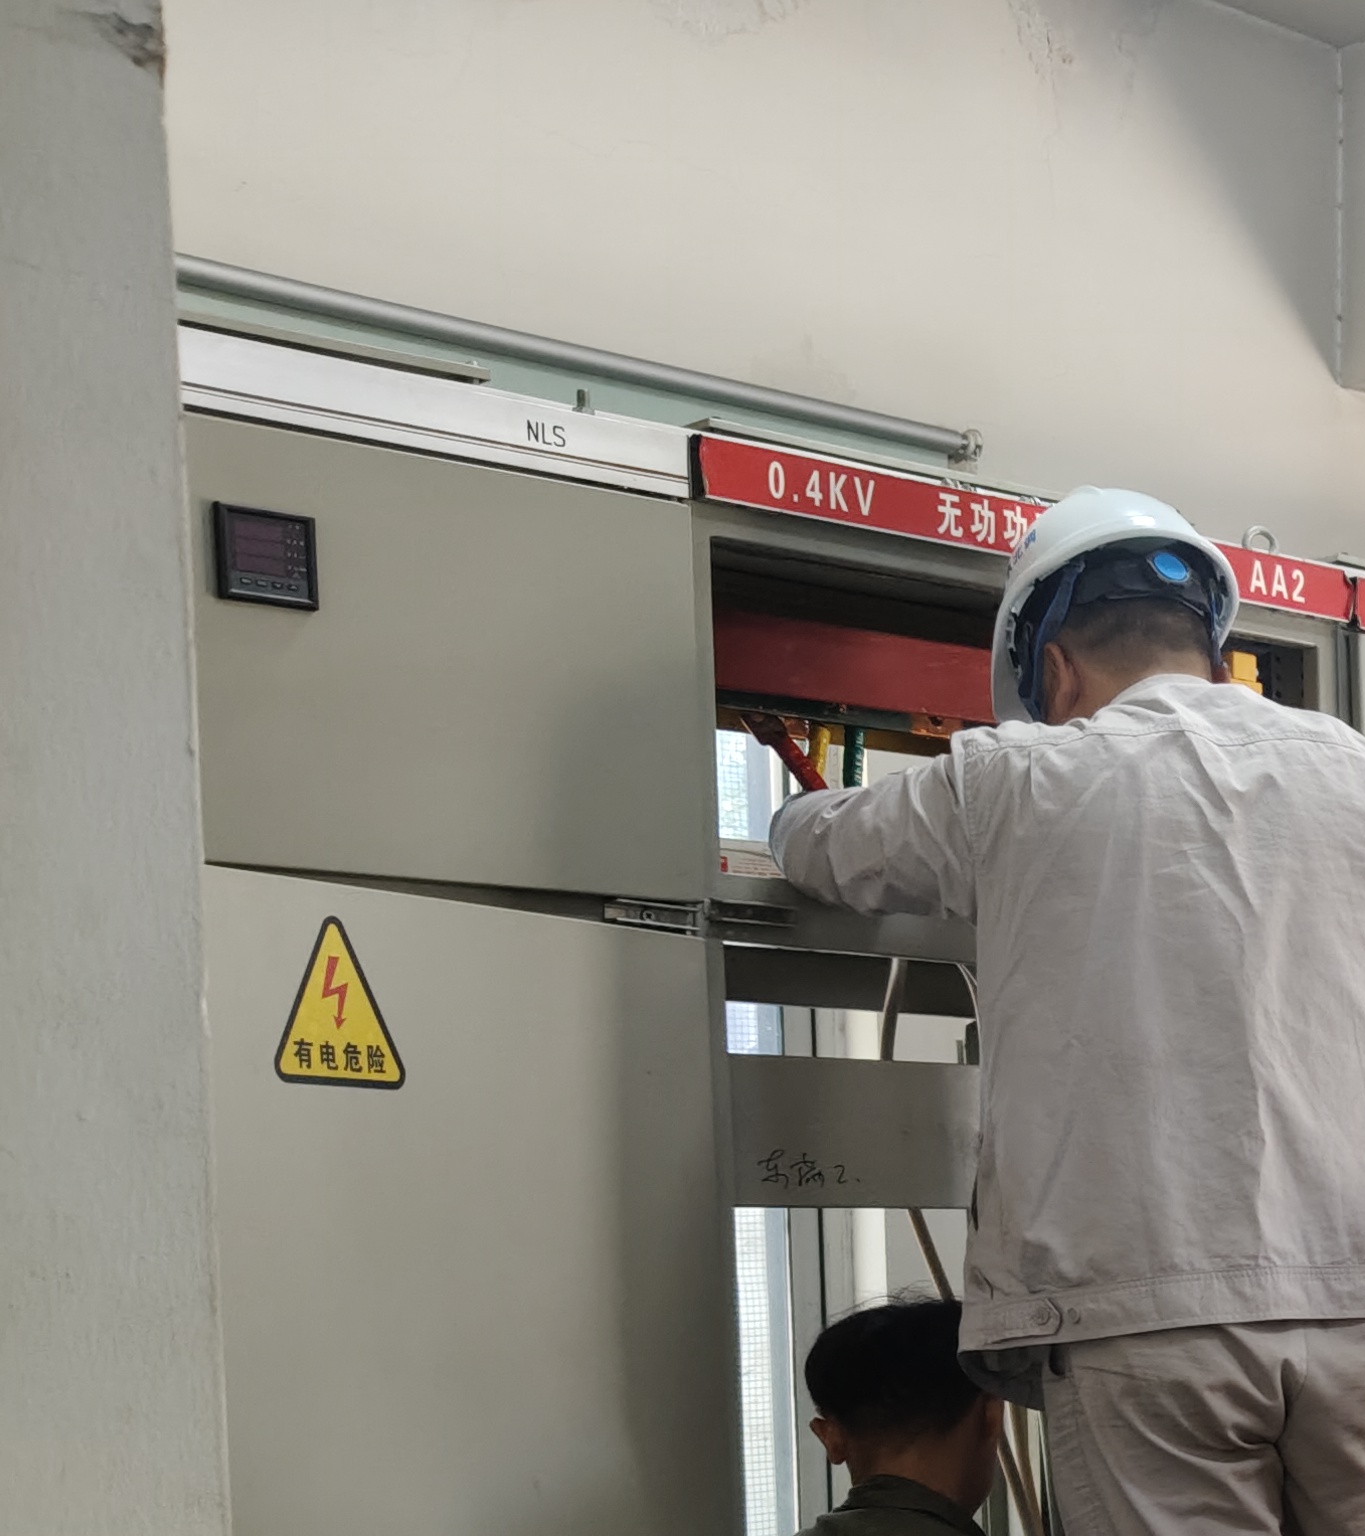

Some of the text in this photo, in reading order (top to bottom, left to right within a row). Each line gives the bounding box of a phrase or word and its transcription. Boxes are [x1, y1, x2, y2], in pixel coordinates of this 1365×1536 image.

[526, 418, 567, 448] NLS
[767, 460, 1307, 604] 0.4KV 无功功 AA2
[293, 1037, 387, 1074] 有电危险
